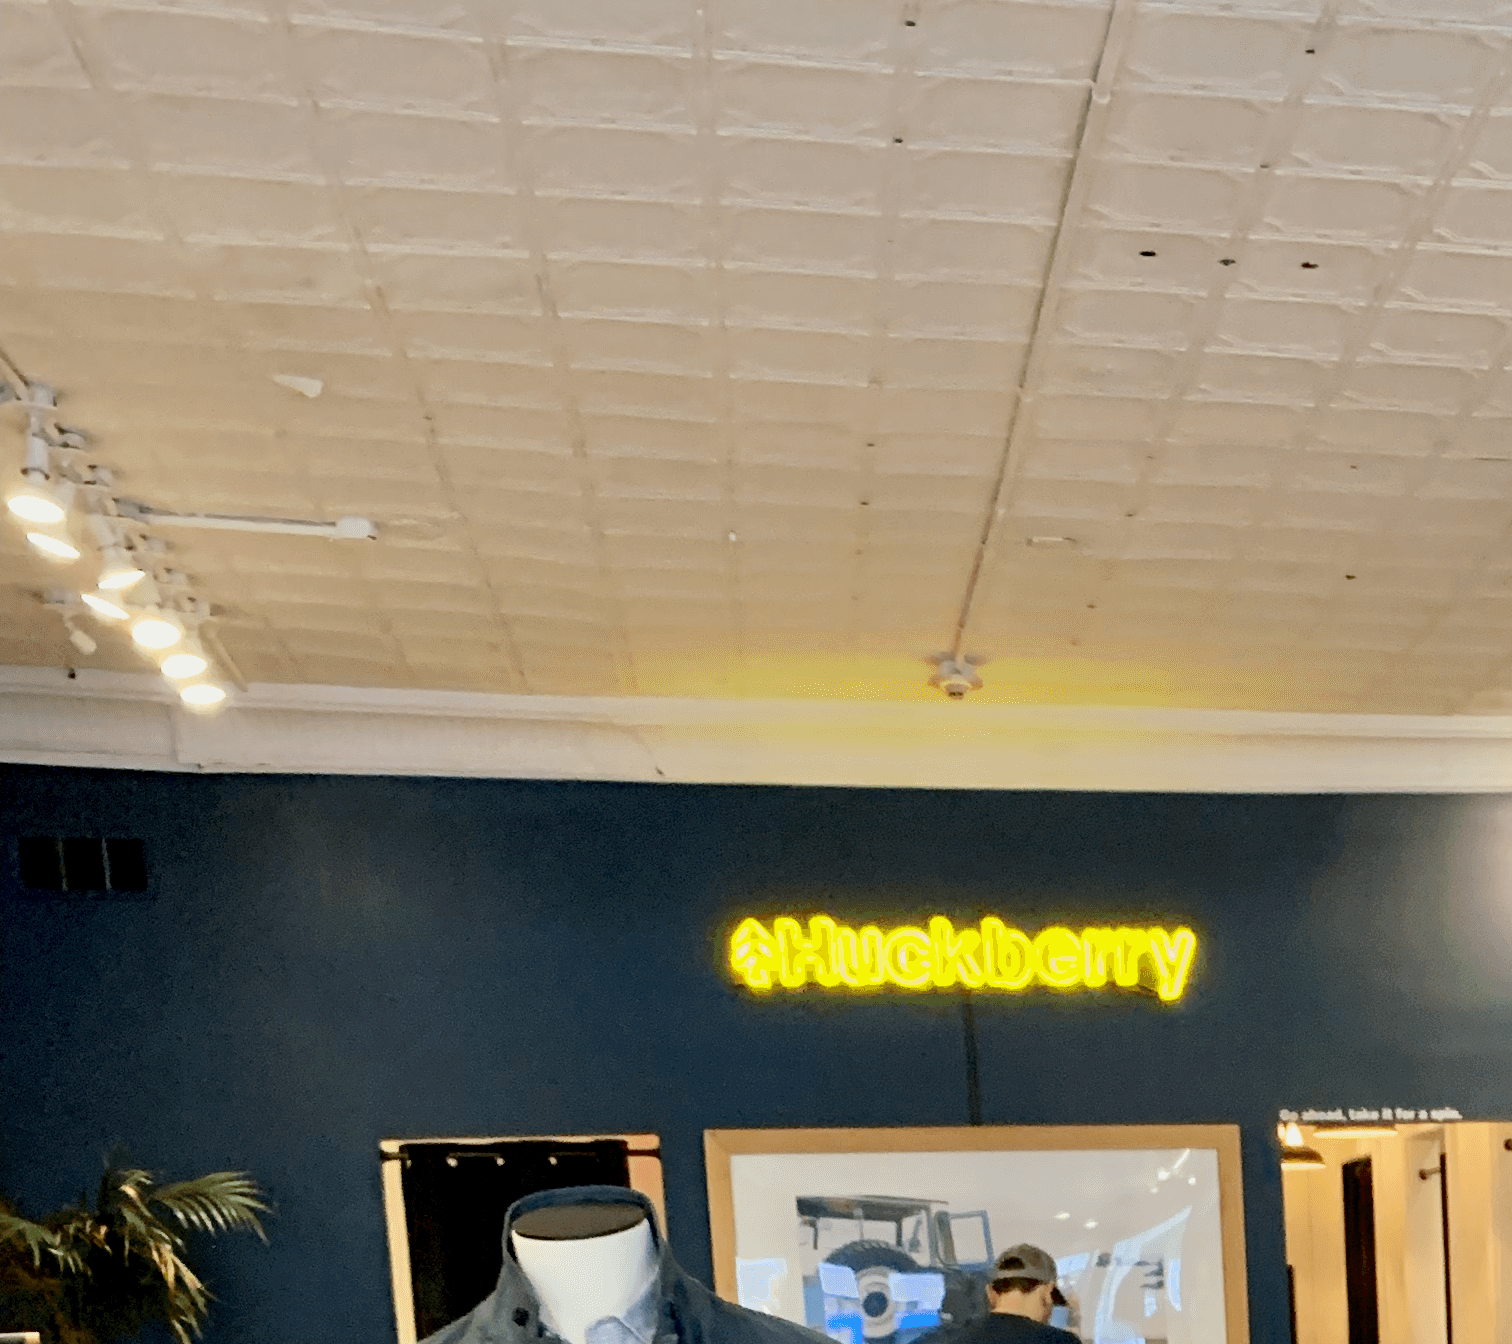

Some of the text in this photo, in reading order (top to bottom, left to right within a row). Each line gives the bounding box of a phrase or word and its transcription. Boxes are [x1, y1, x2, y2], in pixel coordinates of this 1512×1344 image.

[774, 914, 1197, 1002] Huckberry
[1348, 1106, 1380, 1121] take
[1394, 1106, 1416, 1120] for
